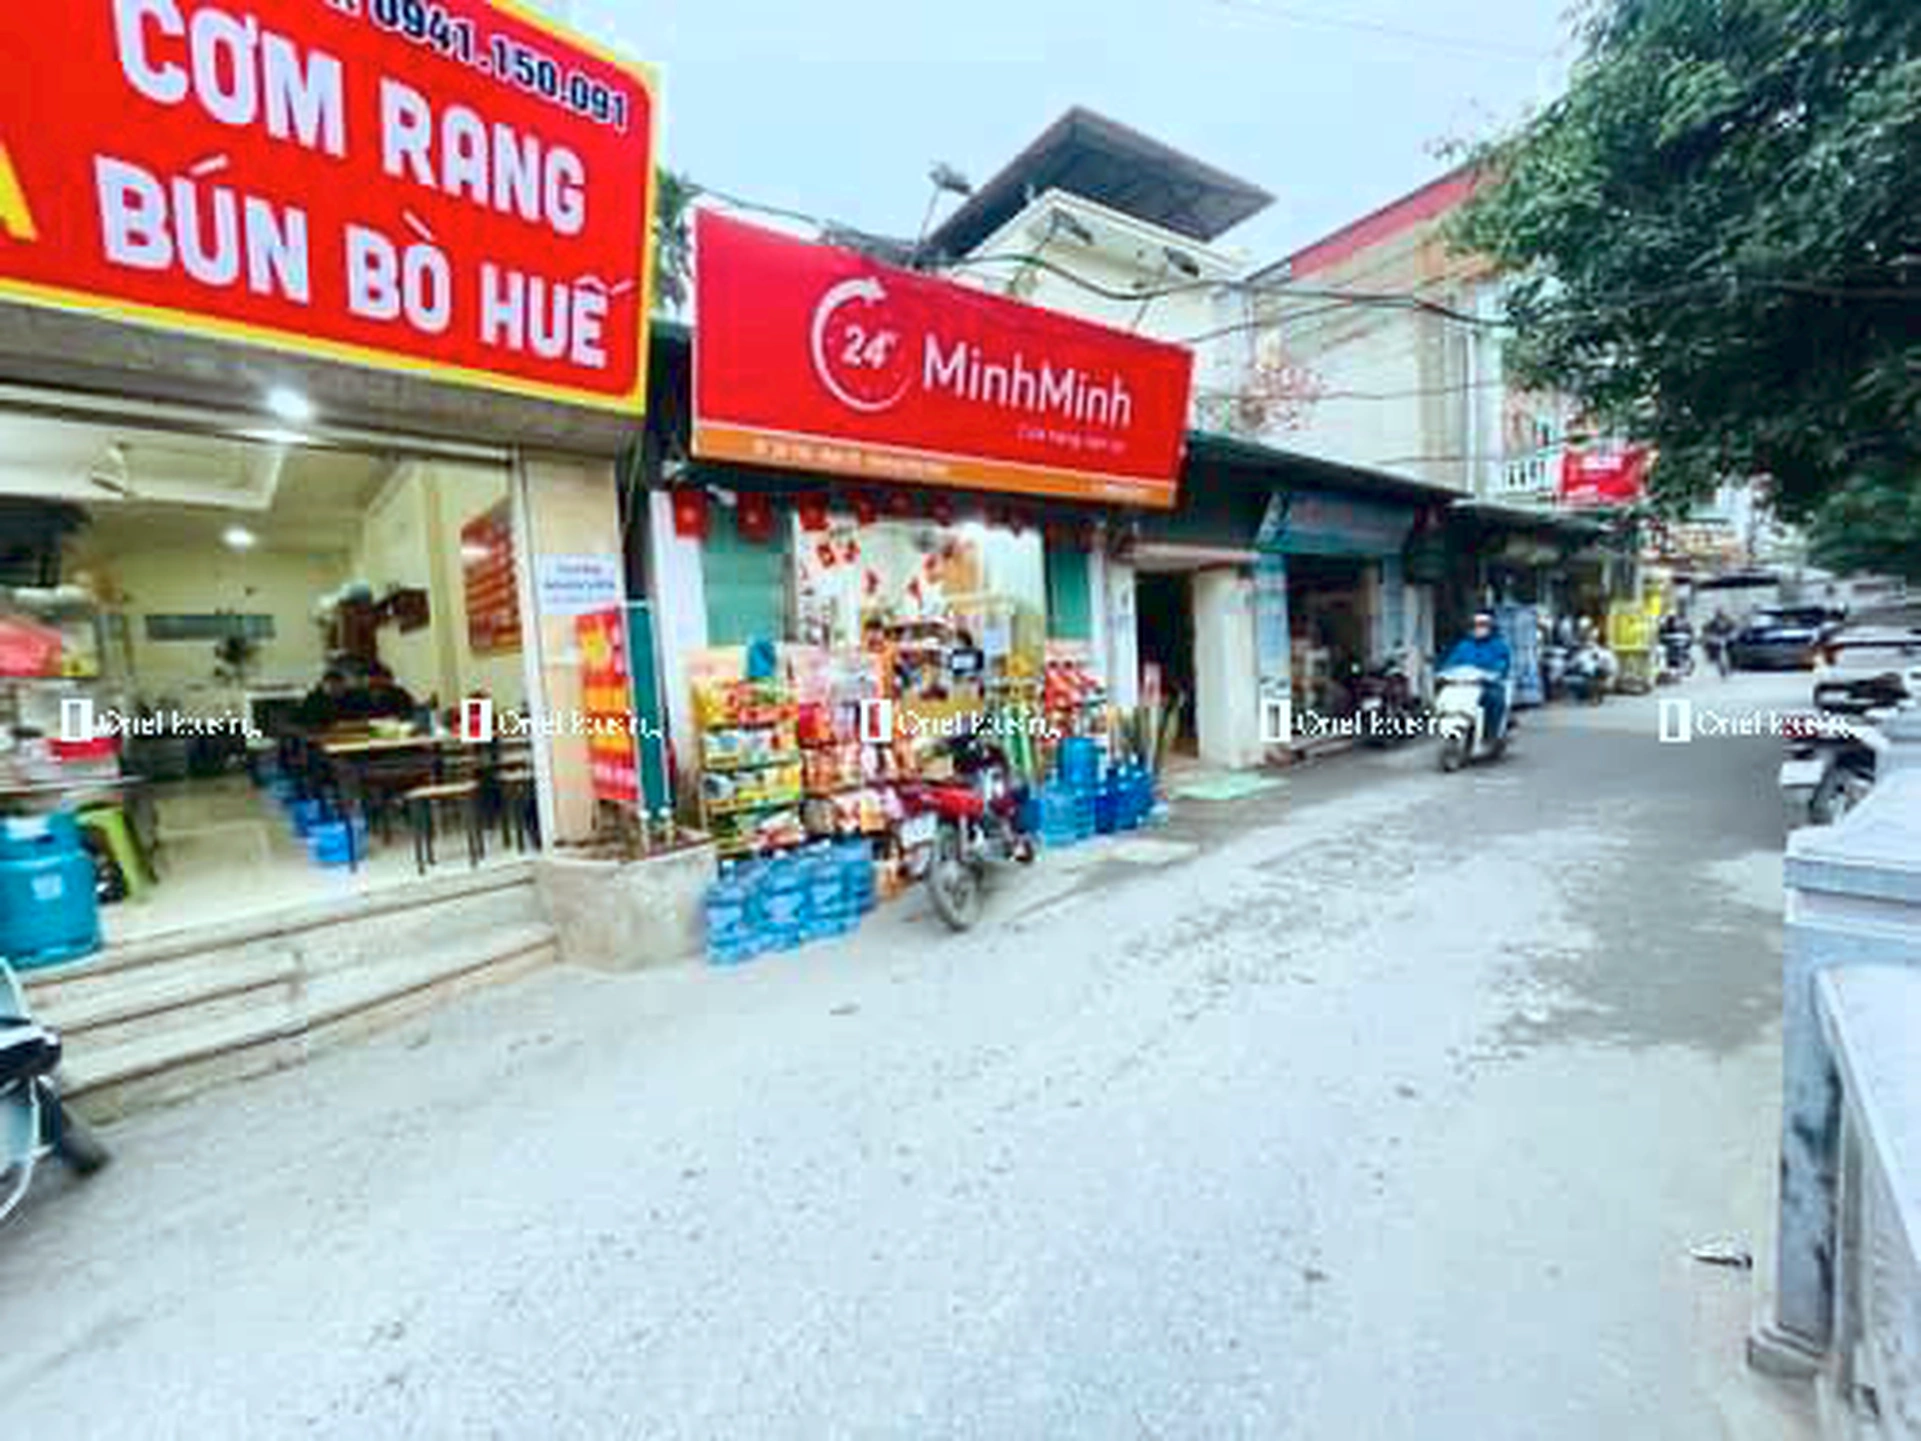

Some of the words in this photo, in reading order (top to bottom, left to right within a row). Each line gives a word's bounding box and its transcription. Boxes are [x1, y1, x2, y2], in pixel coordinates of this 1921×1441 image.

[113, 0, 347, 158] CƠM
[379, 78, 587, 235] RANG
[370, 0, 628, 133] 0941.150.091
[94, 154, 309, 303] BÚN
[344, 211, 451, 333] BÒ
[479, 263, 634, 368] HUẾ
[922, 333, 1133, 429] MinhMinh
